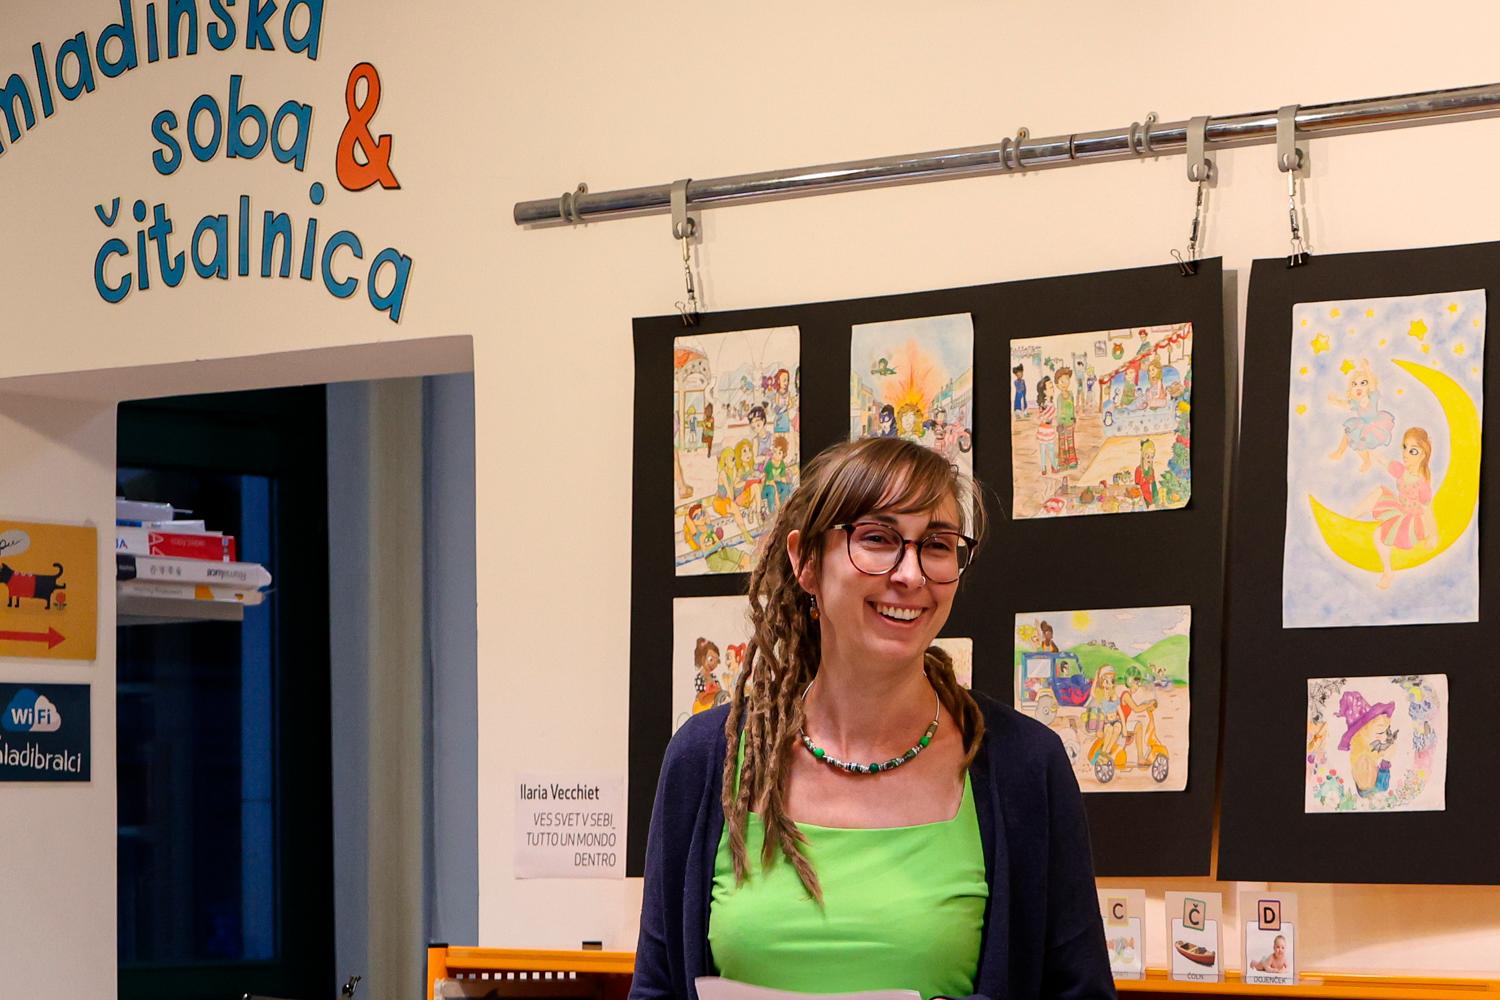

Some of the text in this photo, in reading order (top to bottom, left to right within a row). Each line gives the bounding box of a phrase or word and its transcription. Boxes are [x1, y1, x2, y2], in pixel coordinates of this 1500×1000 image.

[151, 62, 401, 192] soba &
[94, 182, 412, 323] čitalnica
[520, 783, 600, 800] Ilaria Vecchiet
[533, 812, 553, 827] VES
[554, 812, 581, 827] SVET
[582, 812, 589, 827] V
[527, 832, 617, 847] TUTTO UN MONDO
[574, 852, 617, 867] DENTRO
[1112, 903, 1125, 920] C
[1188, 903, 1200, 926] Č
[1263, 906, 1276, 924] D
